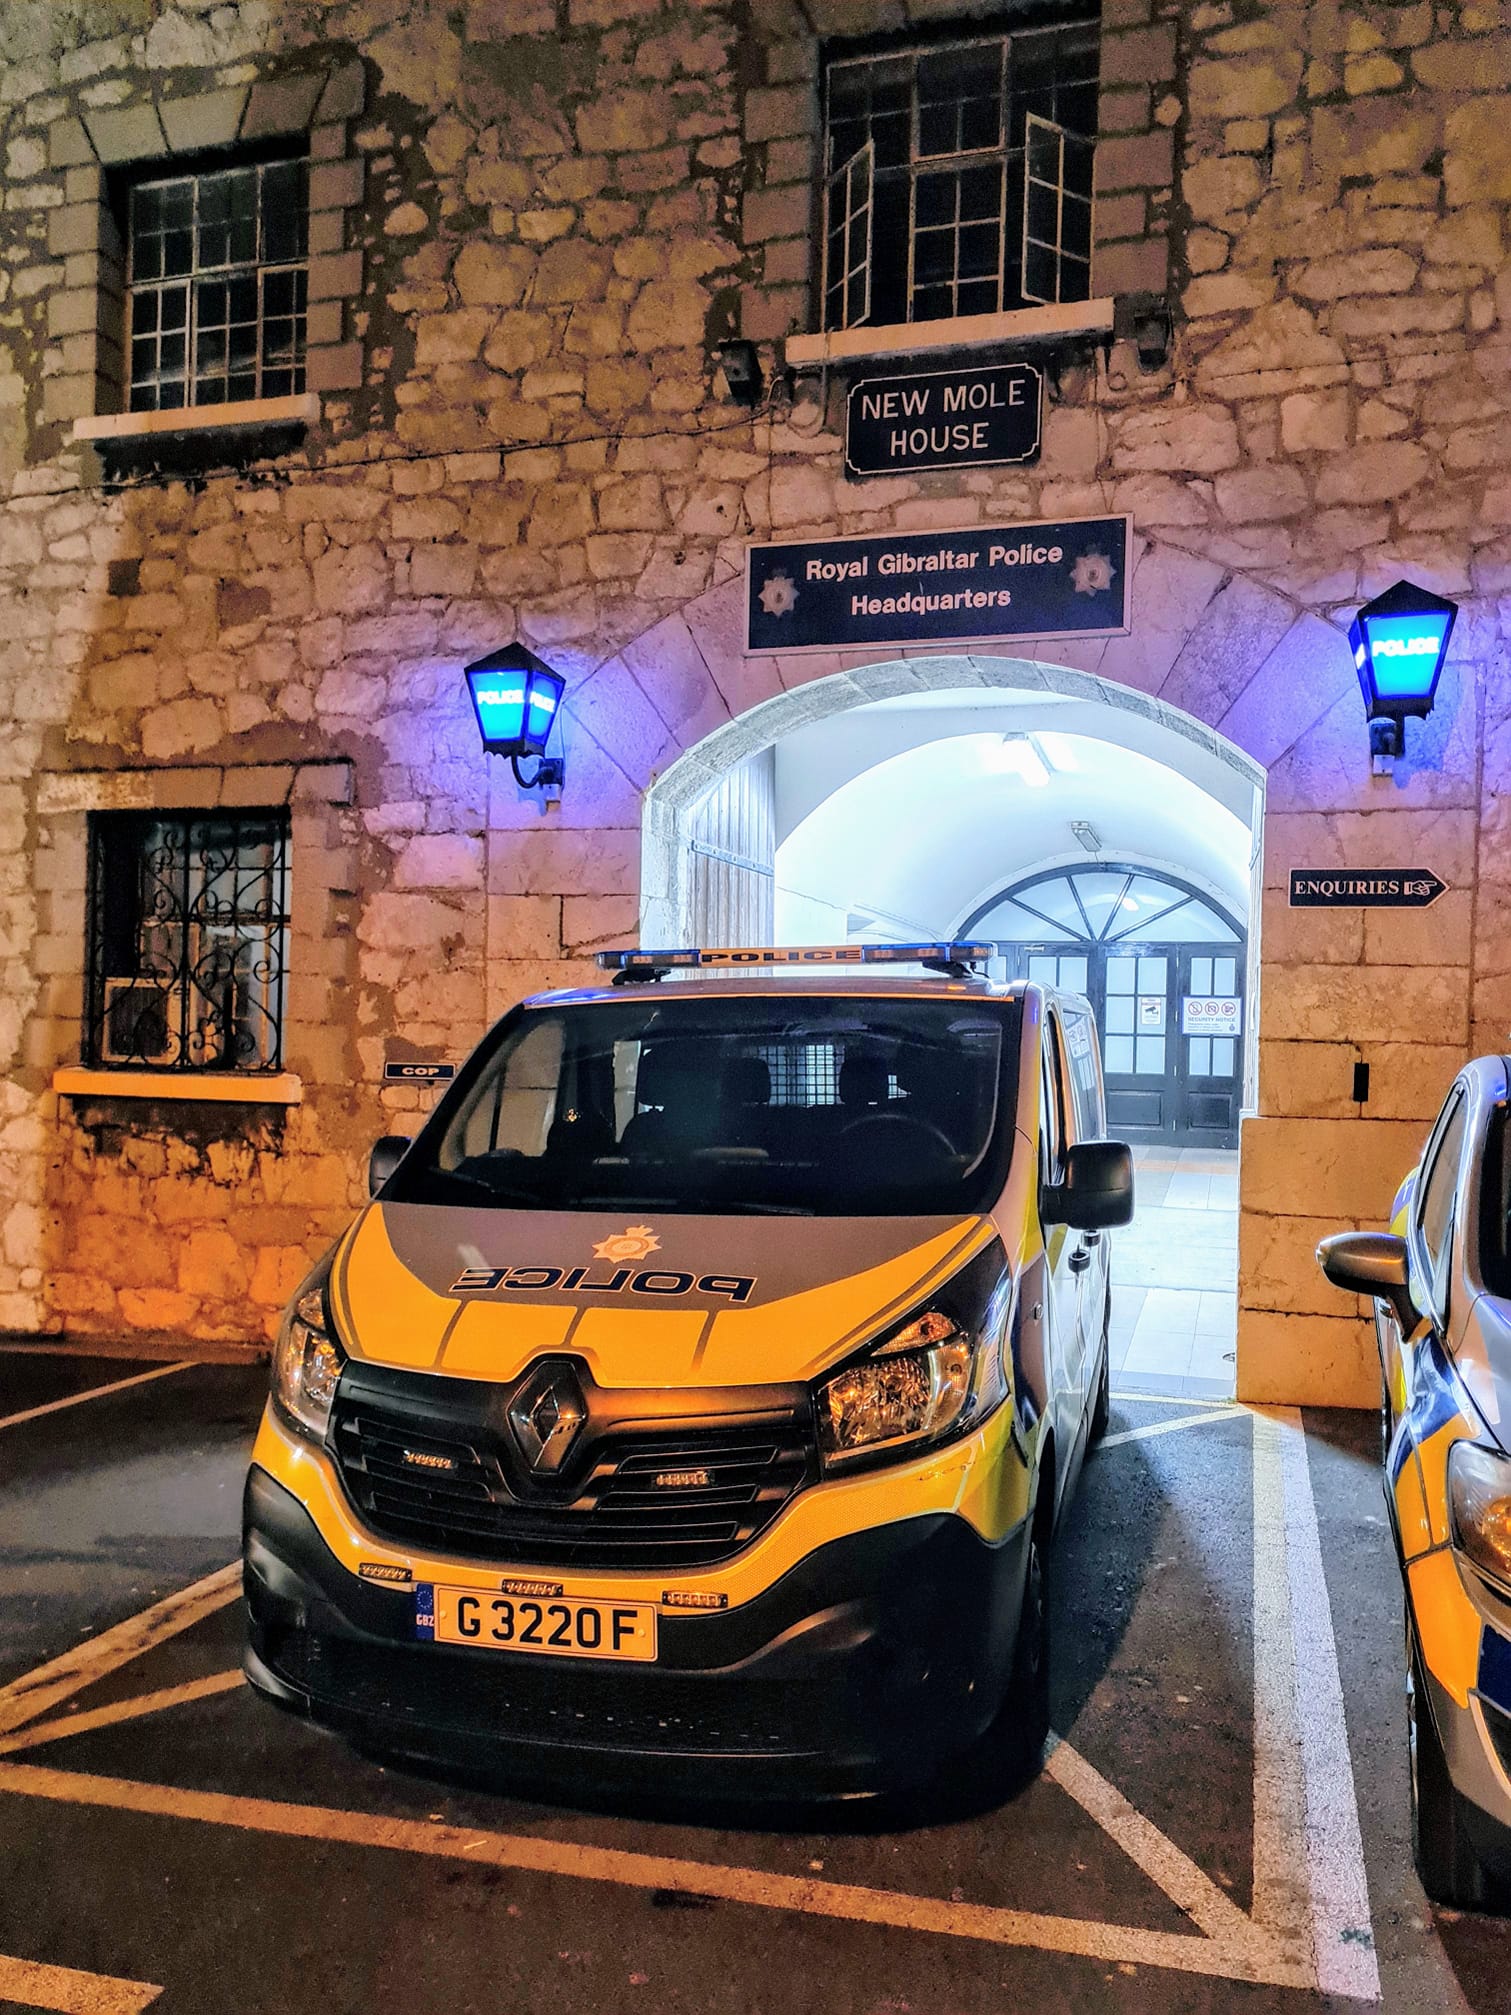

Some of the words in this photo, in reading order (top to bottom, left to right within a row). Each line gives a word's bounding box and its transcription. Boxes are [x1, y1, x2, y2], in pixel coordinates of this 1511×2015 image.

[861, 388, 930, 420] NEW
[943, 379, 1026, 412] MOLE
[890, 422, 990, 457] HOUSE
[805, 556, 868, 583] Royal
[877, 549, 980, 575] Gibraltar
[988, 543, 1064, 568] Police
[850, 587, 1012, 617] Headquarters
[1372, 637, 1439, 657] POLICE
[477, 689, 524, 705] POLICE
[1295, 880, 1400, 897] ENQUIRIES
[701, 950, 861, 963] POLICE
[402, 1067, 440, 1076] COP
[416, 1613, 434, 1627] GBZ
[491, 1600, 601, 1649] 3220
